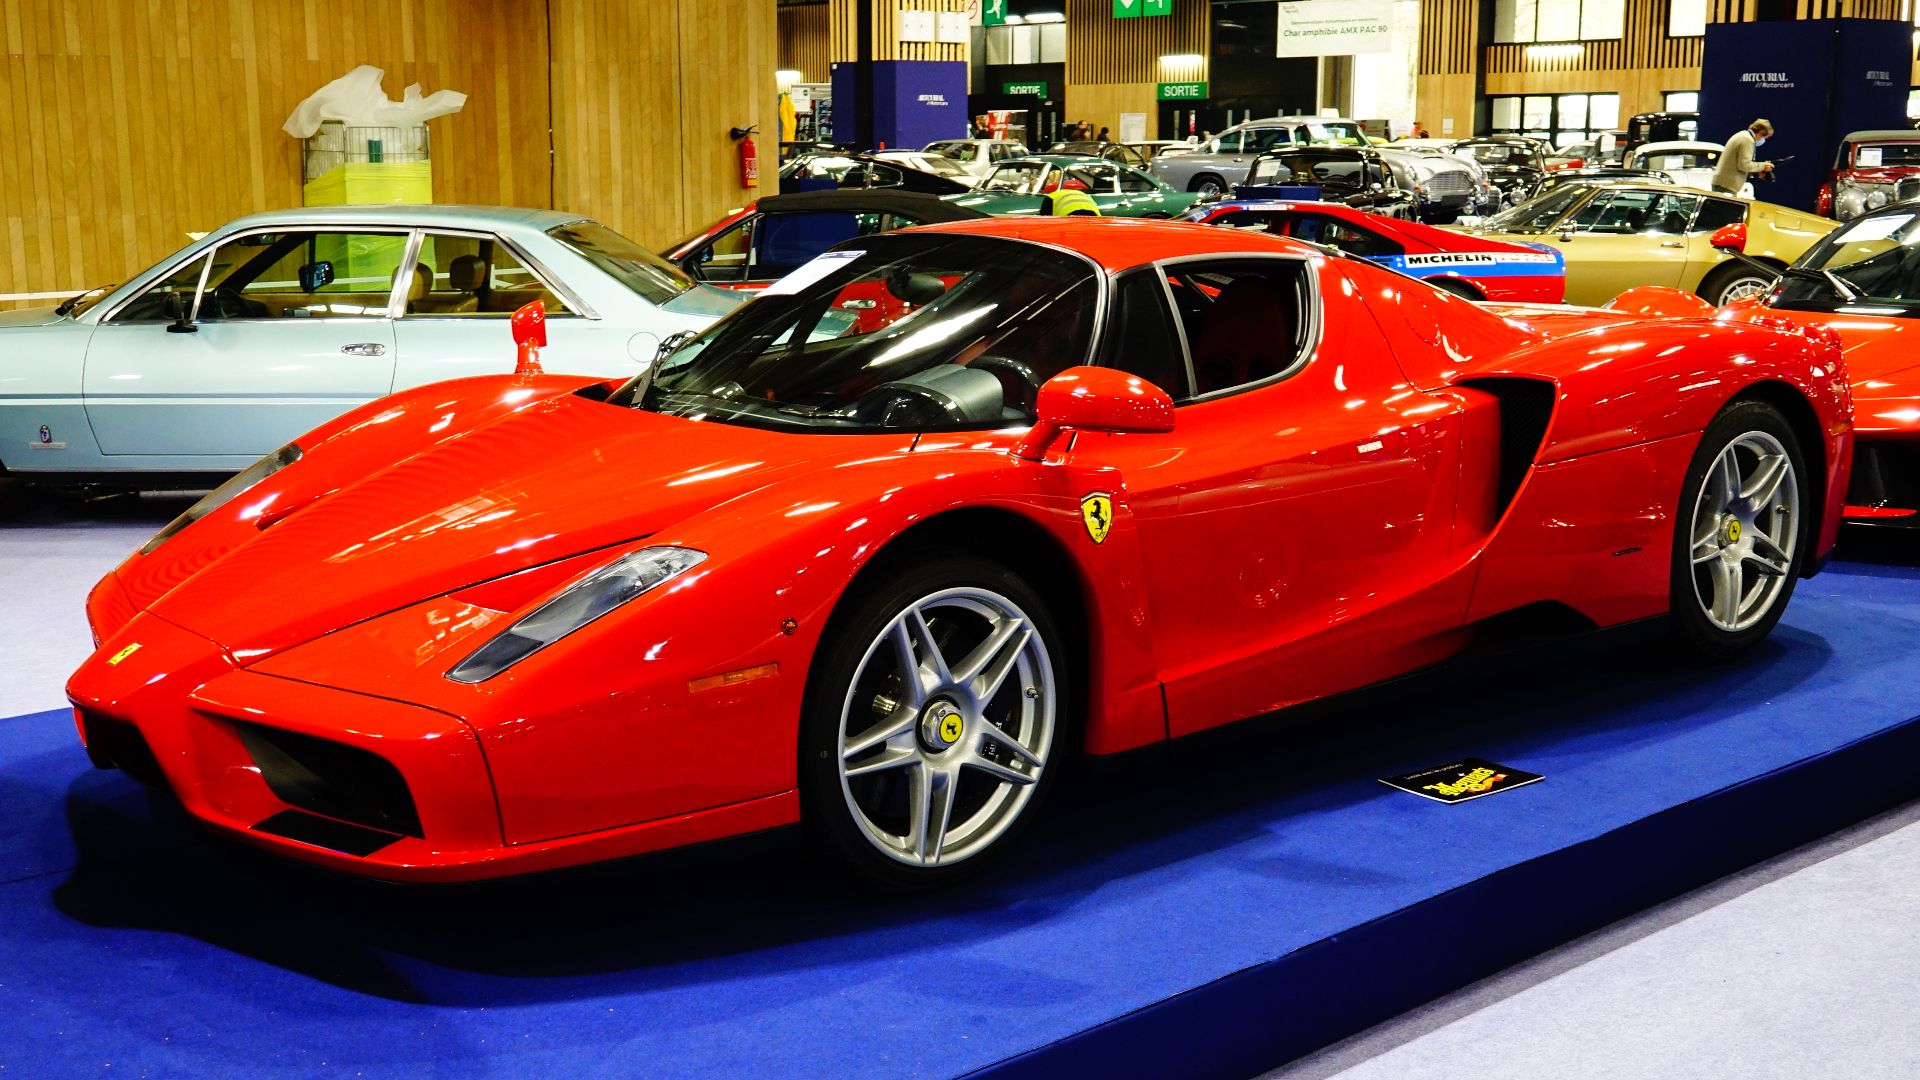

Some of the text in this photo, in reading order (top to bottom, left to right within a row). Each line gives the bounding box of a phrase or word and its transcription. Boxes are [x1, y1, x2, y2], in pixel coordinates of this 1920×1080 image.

[1283, 25, 1388, 37] Char amphibie AMX PAC 90
[1739, 72, 1788, 82] ARTCURIAL
[1163, 84, 1200, 97] SORTIE
[1408, 254, 1492, 265] MICHELIN
